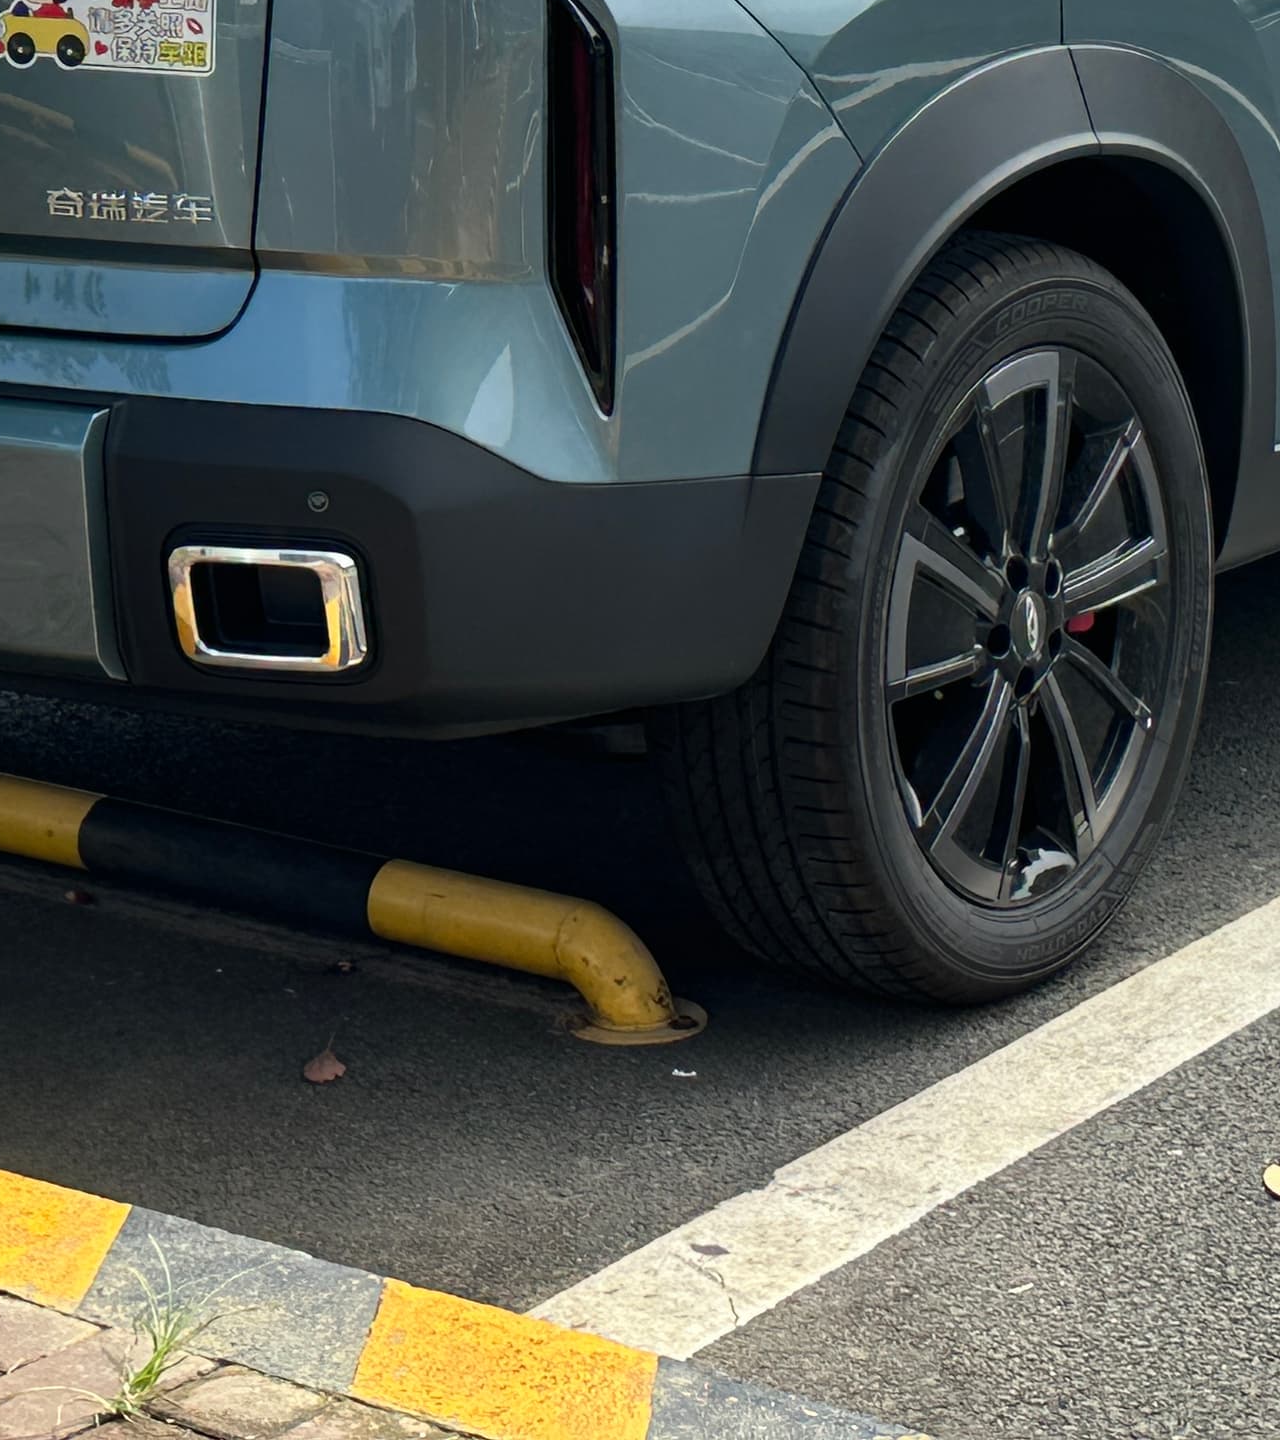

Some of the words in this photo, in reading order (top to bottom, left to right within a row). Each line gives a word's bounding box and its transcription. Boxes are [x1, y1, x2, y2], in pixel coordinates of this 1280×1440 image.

[87, 6, 185, 39] 请多关照
[110, 36, 208, 68] 保持车距
[46, 186, 212, 224] 奇瑞汽车
[994, 293, 1089, 335] COOPER
